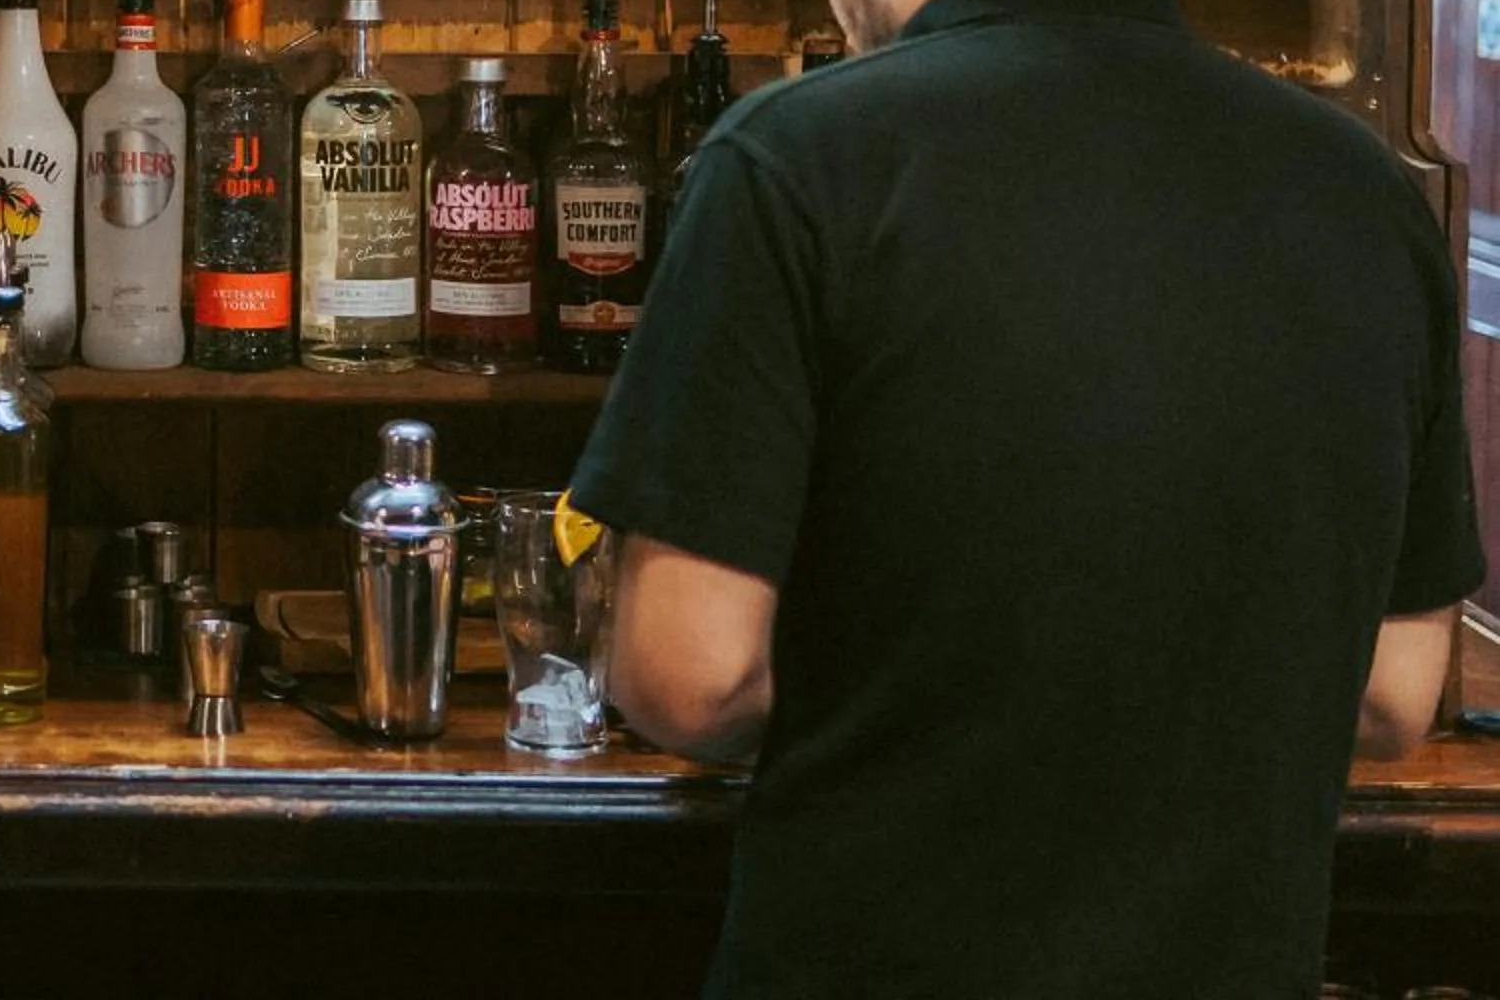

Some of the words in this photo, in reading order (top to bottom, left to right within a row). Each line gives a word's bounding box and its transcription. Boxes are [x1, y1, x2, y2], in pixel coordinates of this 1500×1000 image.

[86, 151, 176, 180] ARCHERS
[228, 136, 260, 173] JJ
[315, 139, 415, 166] ABSOLUT
[320, 166, 411, 192] VANILIA
[436, 182, 530, 207] ABSOLUT
[429, 205, 535, 232] RASPBERRI
[562, 200, 642, 220] SOUTHERN
[567, 223, 637, 243] COMFORT
[223, 300, 267, 311] VODKA
